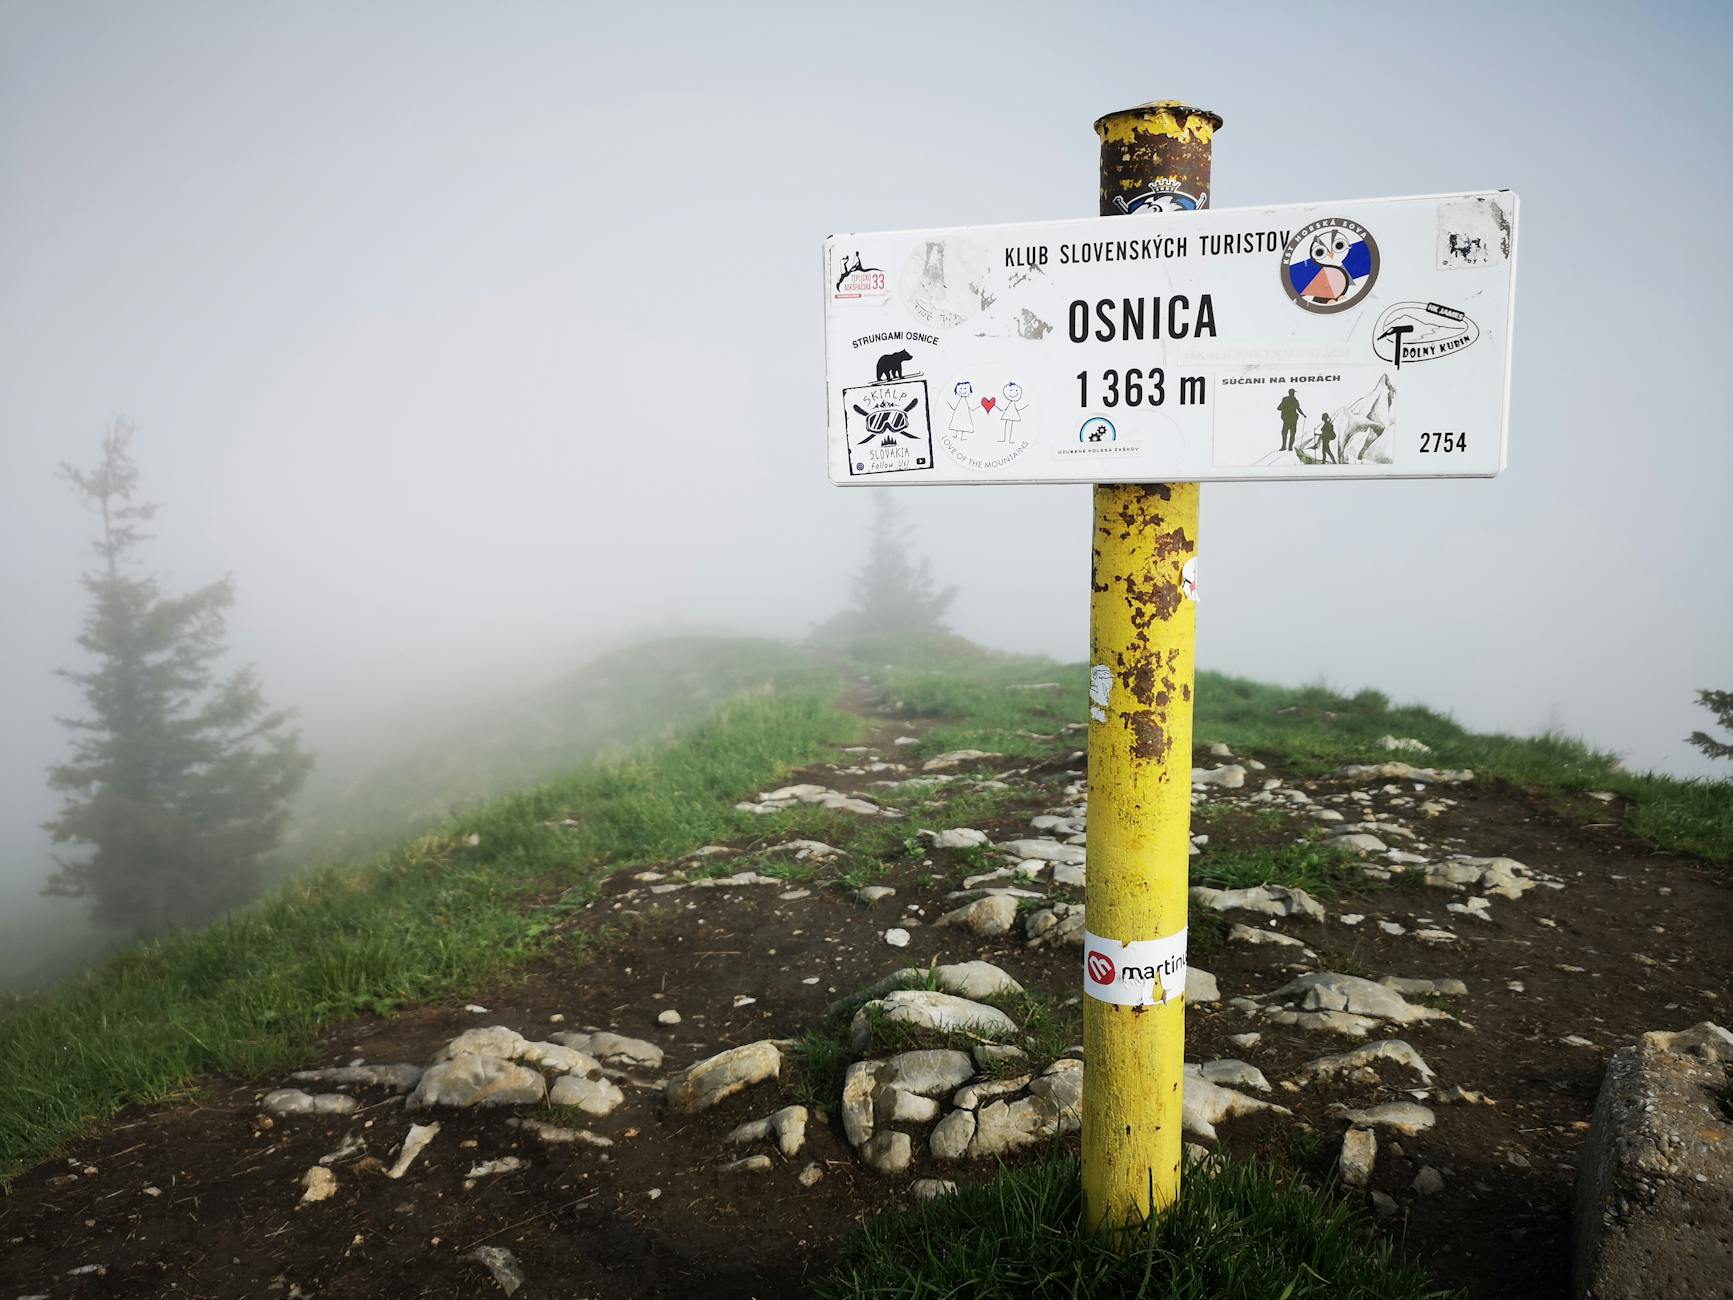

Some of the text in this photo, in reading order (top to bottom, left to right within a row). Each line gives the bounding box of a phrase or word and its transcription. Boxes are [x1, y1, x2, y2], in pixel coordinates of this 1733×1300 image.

[1343, 220, 1367, 239] SOVA
[1005, 231, 1290, 267] KLUB SLOVENSKÝCH TURISTOV
[872, 273, 885, 289] 33
[1069, 294, 1217, 343] OSNICA
[852, 332, 939, 348] STRUNGAMI OSNICE
[1180, 375, 1206, 405] m
[941, 435, 1029, 468] LOVE OF THE MOUNTAINS
[1419, 432, 1466, 452] 2754
[870, 447, 909, 460] SLOVAKIA
